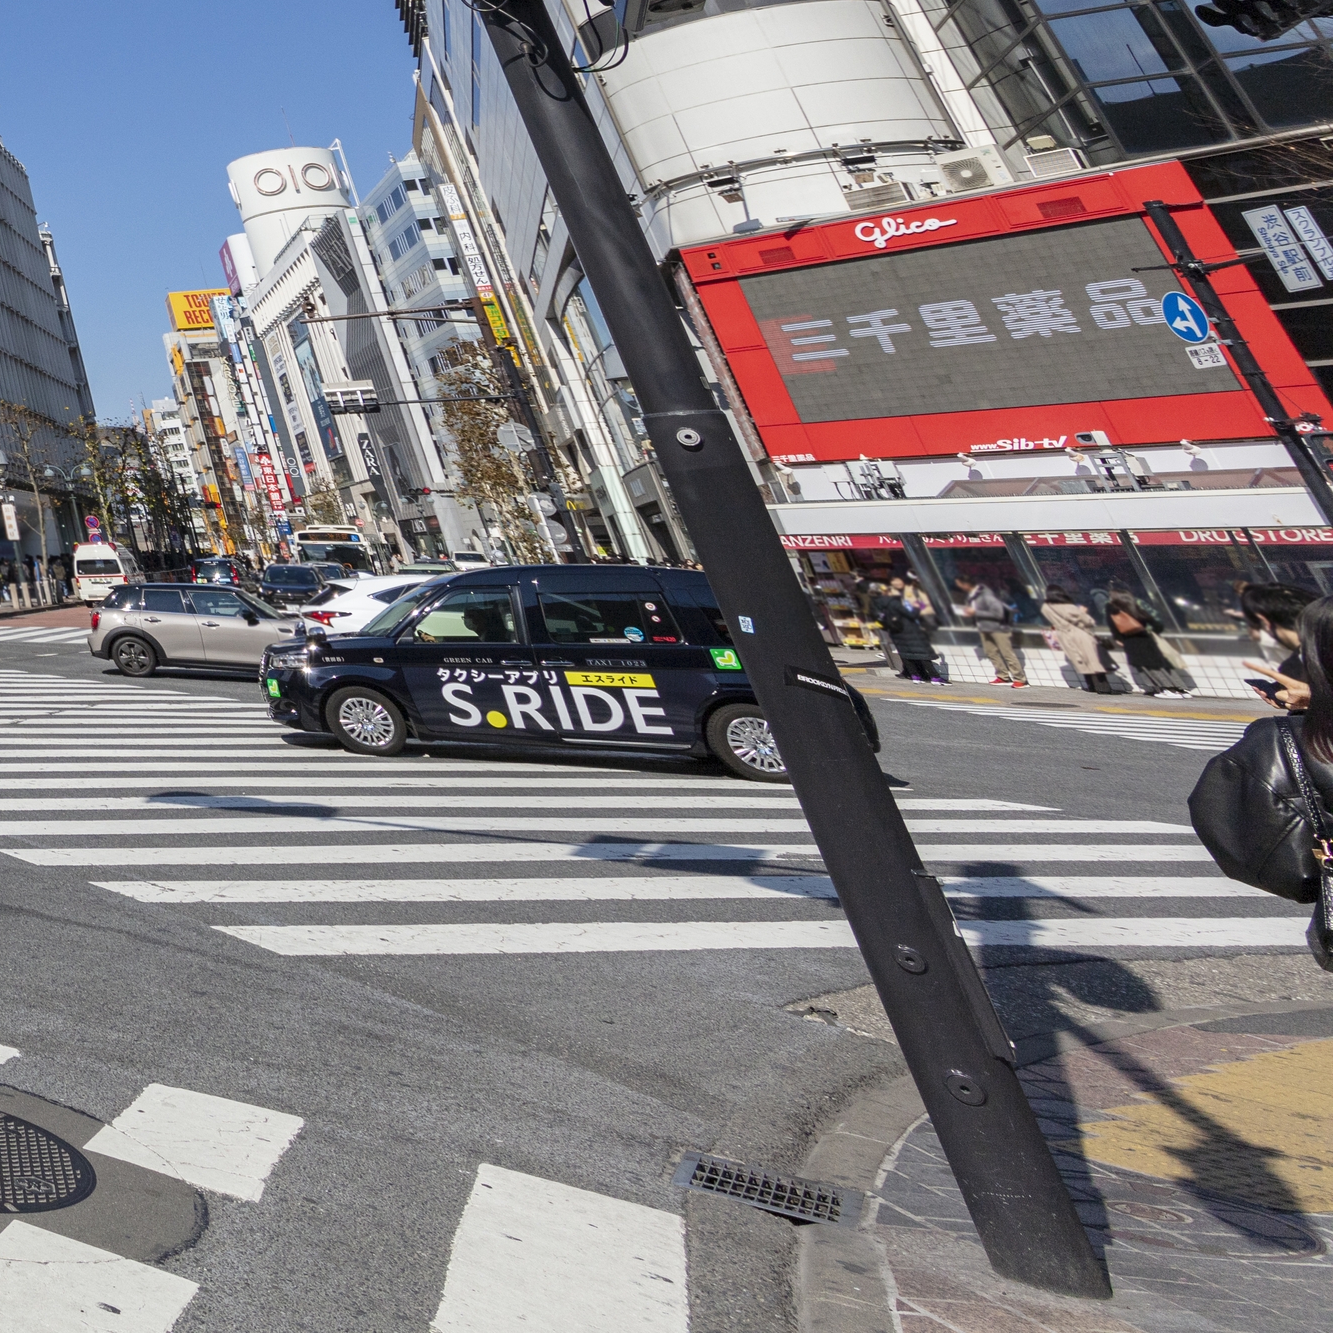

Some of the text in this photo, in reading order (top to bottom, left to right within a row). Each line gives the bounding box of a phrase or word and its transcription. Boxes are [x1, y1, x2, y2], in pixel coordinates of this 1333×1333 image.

[459, 231, 476, 253] 内科
[854, 216, 958, 249] Glico
[1260, 213, 1313, 283] 渋谷駅前
[1257, 226, 1290, 277] Shibuya Sta.
[467, 256, 489, 285] 処方せん
[779, 277, 1165, 364] 三千里薬品
[219, 356, 241, 409] KARAOKE
[360, 438, 381, 476] ZARA
[435, 667, 559, 686] タクシーアプリ
[475, 657, 494, 665] CAB
[587, 658, 647, 668] TAXI 1023
[581, 673, 639, 687] エスライド
